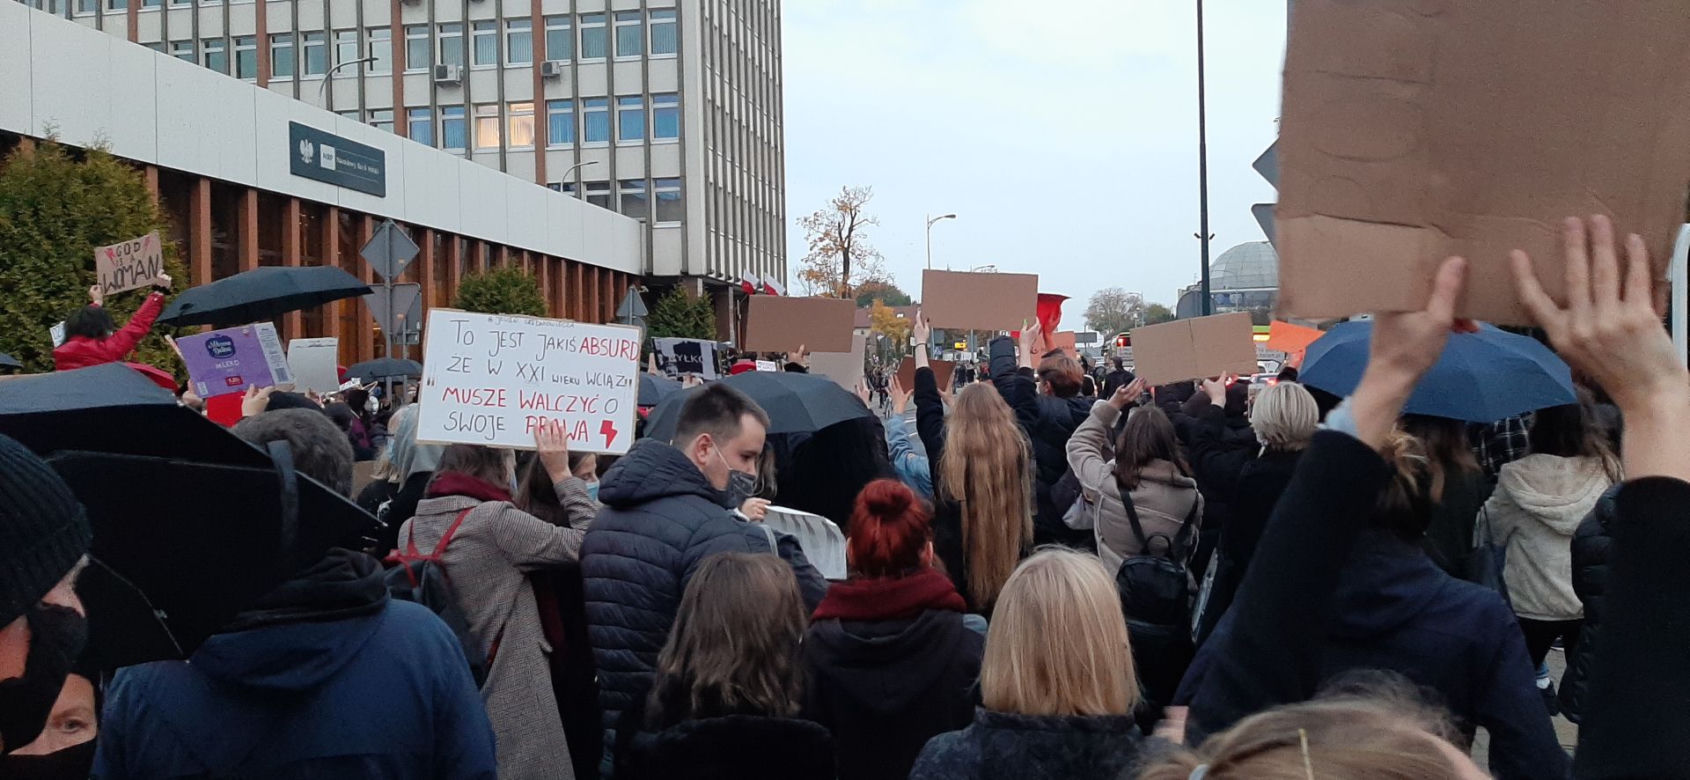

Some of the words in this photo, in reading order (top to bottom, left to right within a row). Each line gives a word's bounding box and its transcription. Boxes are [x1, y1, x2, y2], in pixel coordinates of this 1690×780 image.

[116, 242, 140, 257] GOD
[103, 254, 159, 294] WOMAN
[450, 320, 474, 345] TO
[488, 331, 525, 357] JEST
[536, 334, 577, 361] JAKIŚ
[579, 337, 640, 361] ABSURD
[215, 360, 240, 370] MLEKO
[488, 360, 503, 375] W
[516, 361, 544, 382] XXI
[552, 374, 580, 385] WIEKU
[520, 389, 600, 414] WALCZYĆ
[604, 398, 618, 414] O
[443, 411, 506, 440] SWOJE
